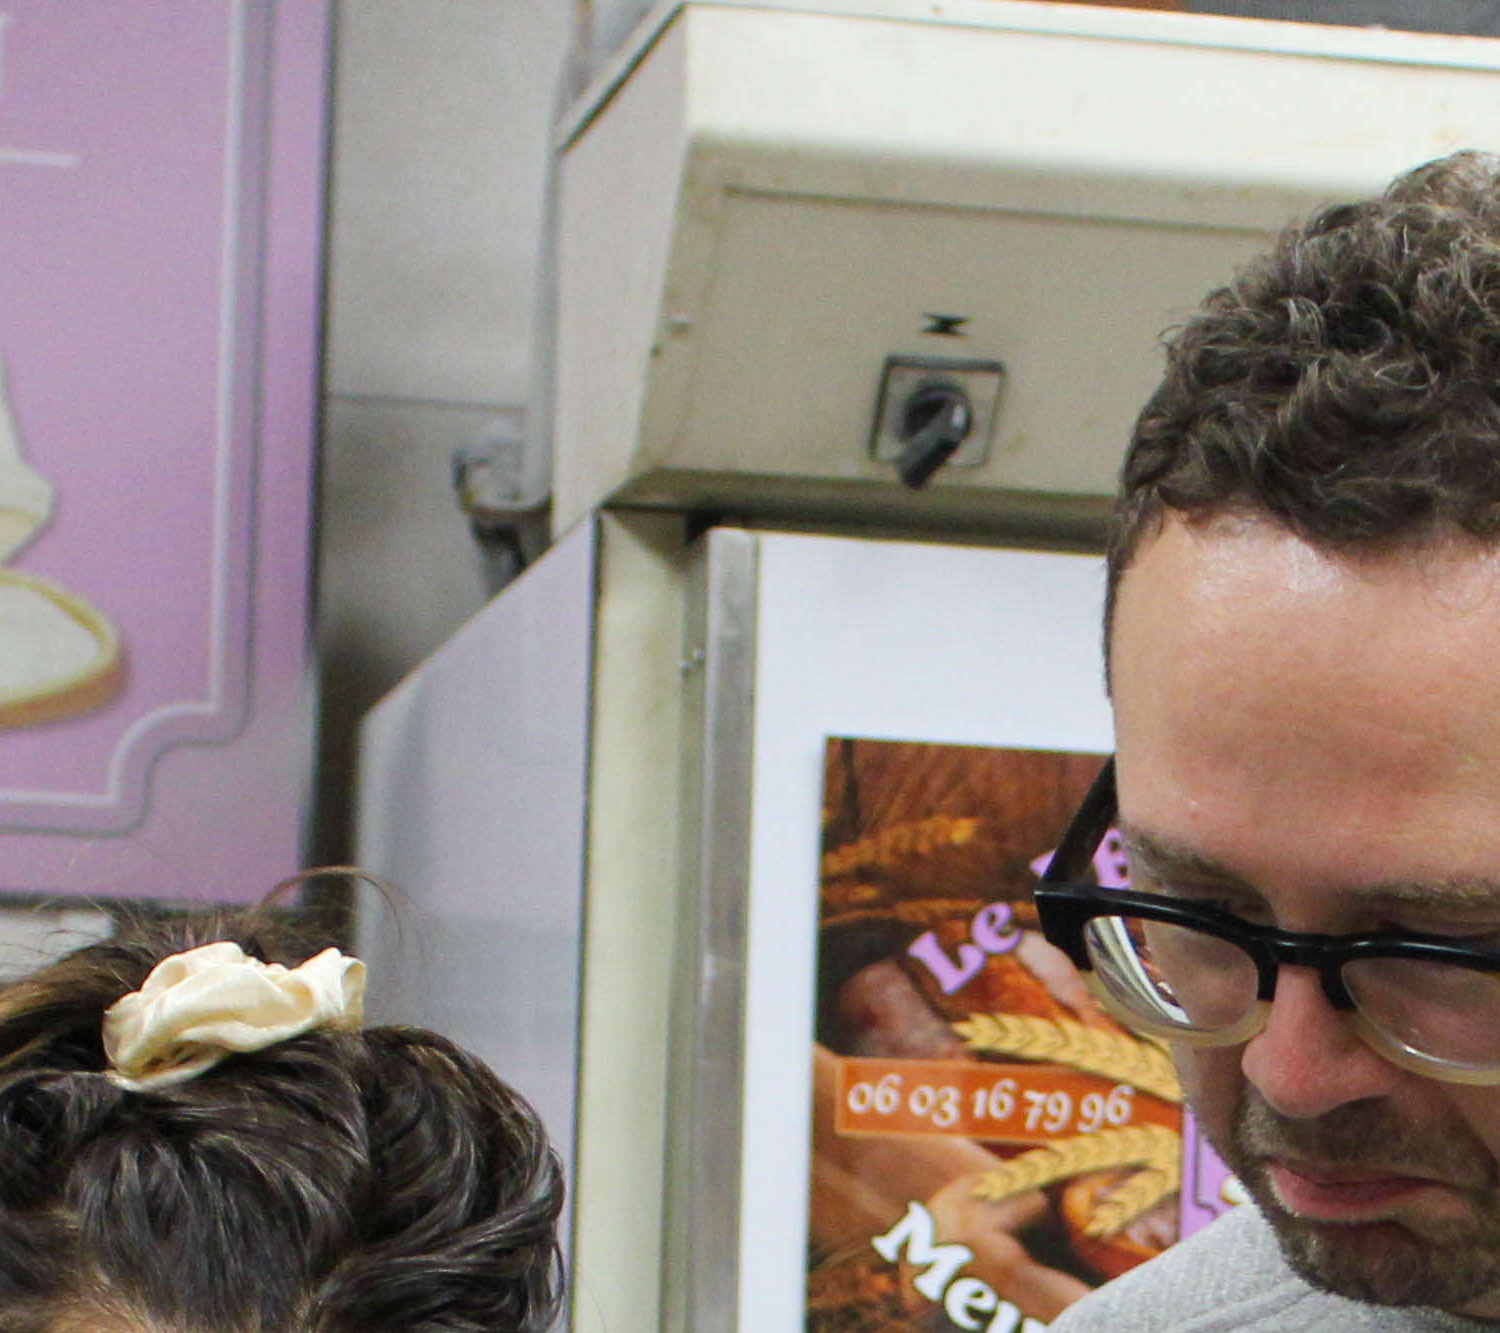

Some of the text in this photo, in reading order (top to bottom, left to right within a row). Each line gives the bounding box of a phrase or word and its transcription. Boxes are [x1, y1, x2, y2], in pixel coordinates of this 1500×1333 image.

[907, 902, 1023, 996] Le
[847, 1073, 1135, 1134] 06 03 16 79 96
